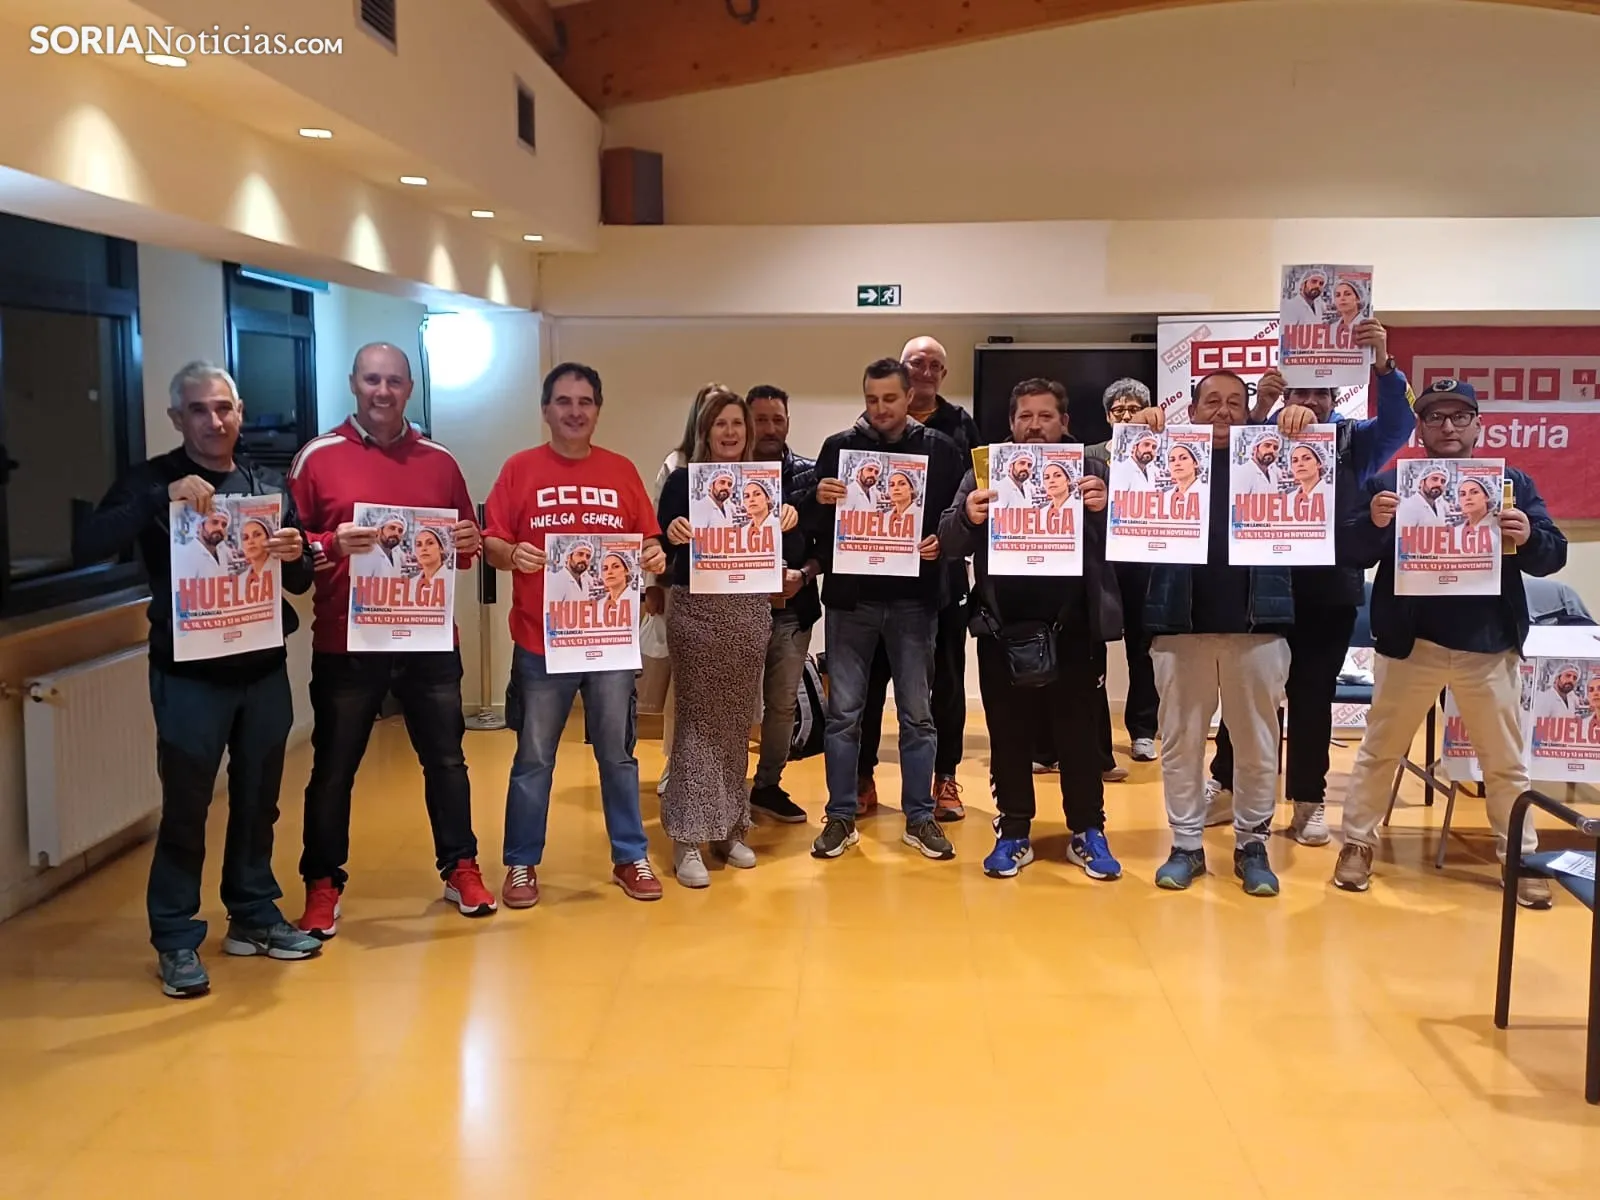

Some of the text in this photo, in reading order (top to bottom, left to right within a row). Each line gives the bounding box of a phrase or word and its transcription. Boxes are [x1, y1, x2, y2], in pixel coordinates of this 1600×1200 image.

[537, 486, 618, 508] CCOO
[1114, 490, 1200, 520] HUELGA
[1236, 494, 1326, 521] HUELGA
[530, 512, 624, 529] HUELGA GENERAL
[840, 511, 914, 538] HUELGA
[994, 508, 1075, 534] HUELGA
[694, 526, 774, 554] HUELGA
[1402, 526, 1492, 554] HUELGA
[180, 570, 273, 610] HUELGA
[357, 576, 445, 606] HUELGA
[550, 600, 631, 629] HUELGA
